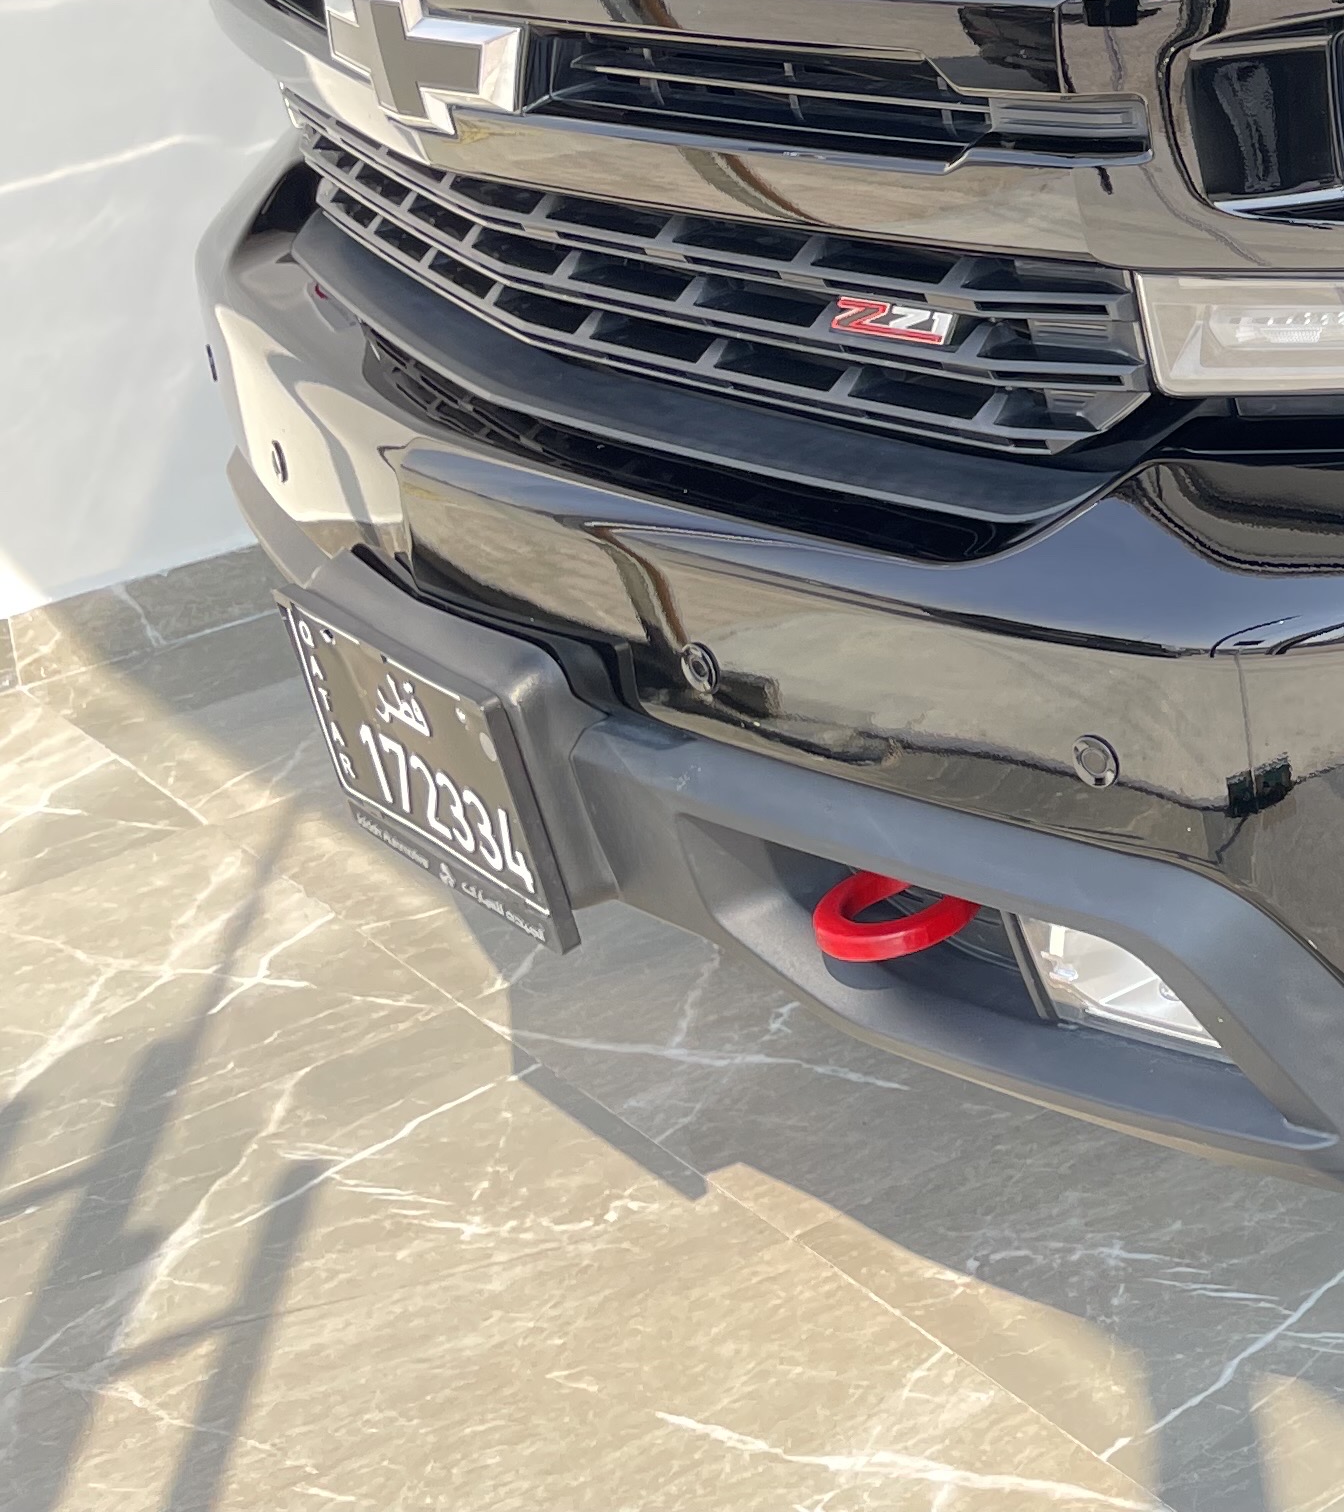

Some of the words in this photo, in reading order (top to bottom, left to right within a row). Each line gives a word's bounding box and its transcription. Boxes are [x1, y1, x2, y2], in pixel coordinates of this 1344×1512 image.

[831, 296, 953, 345] Z71
[298, 619, 358, 780] QATAR
[375, 672, 431, 737] قطر
[360, 723, 535, 894] 172334
